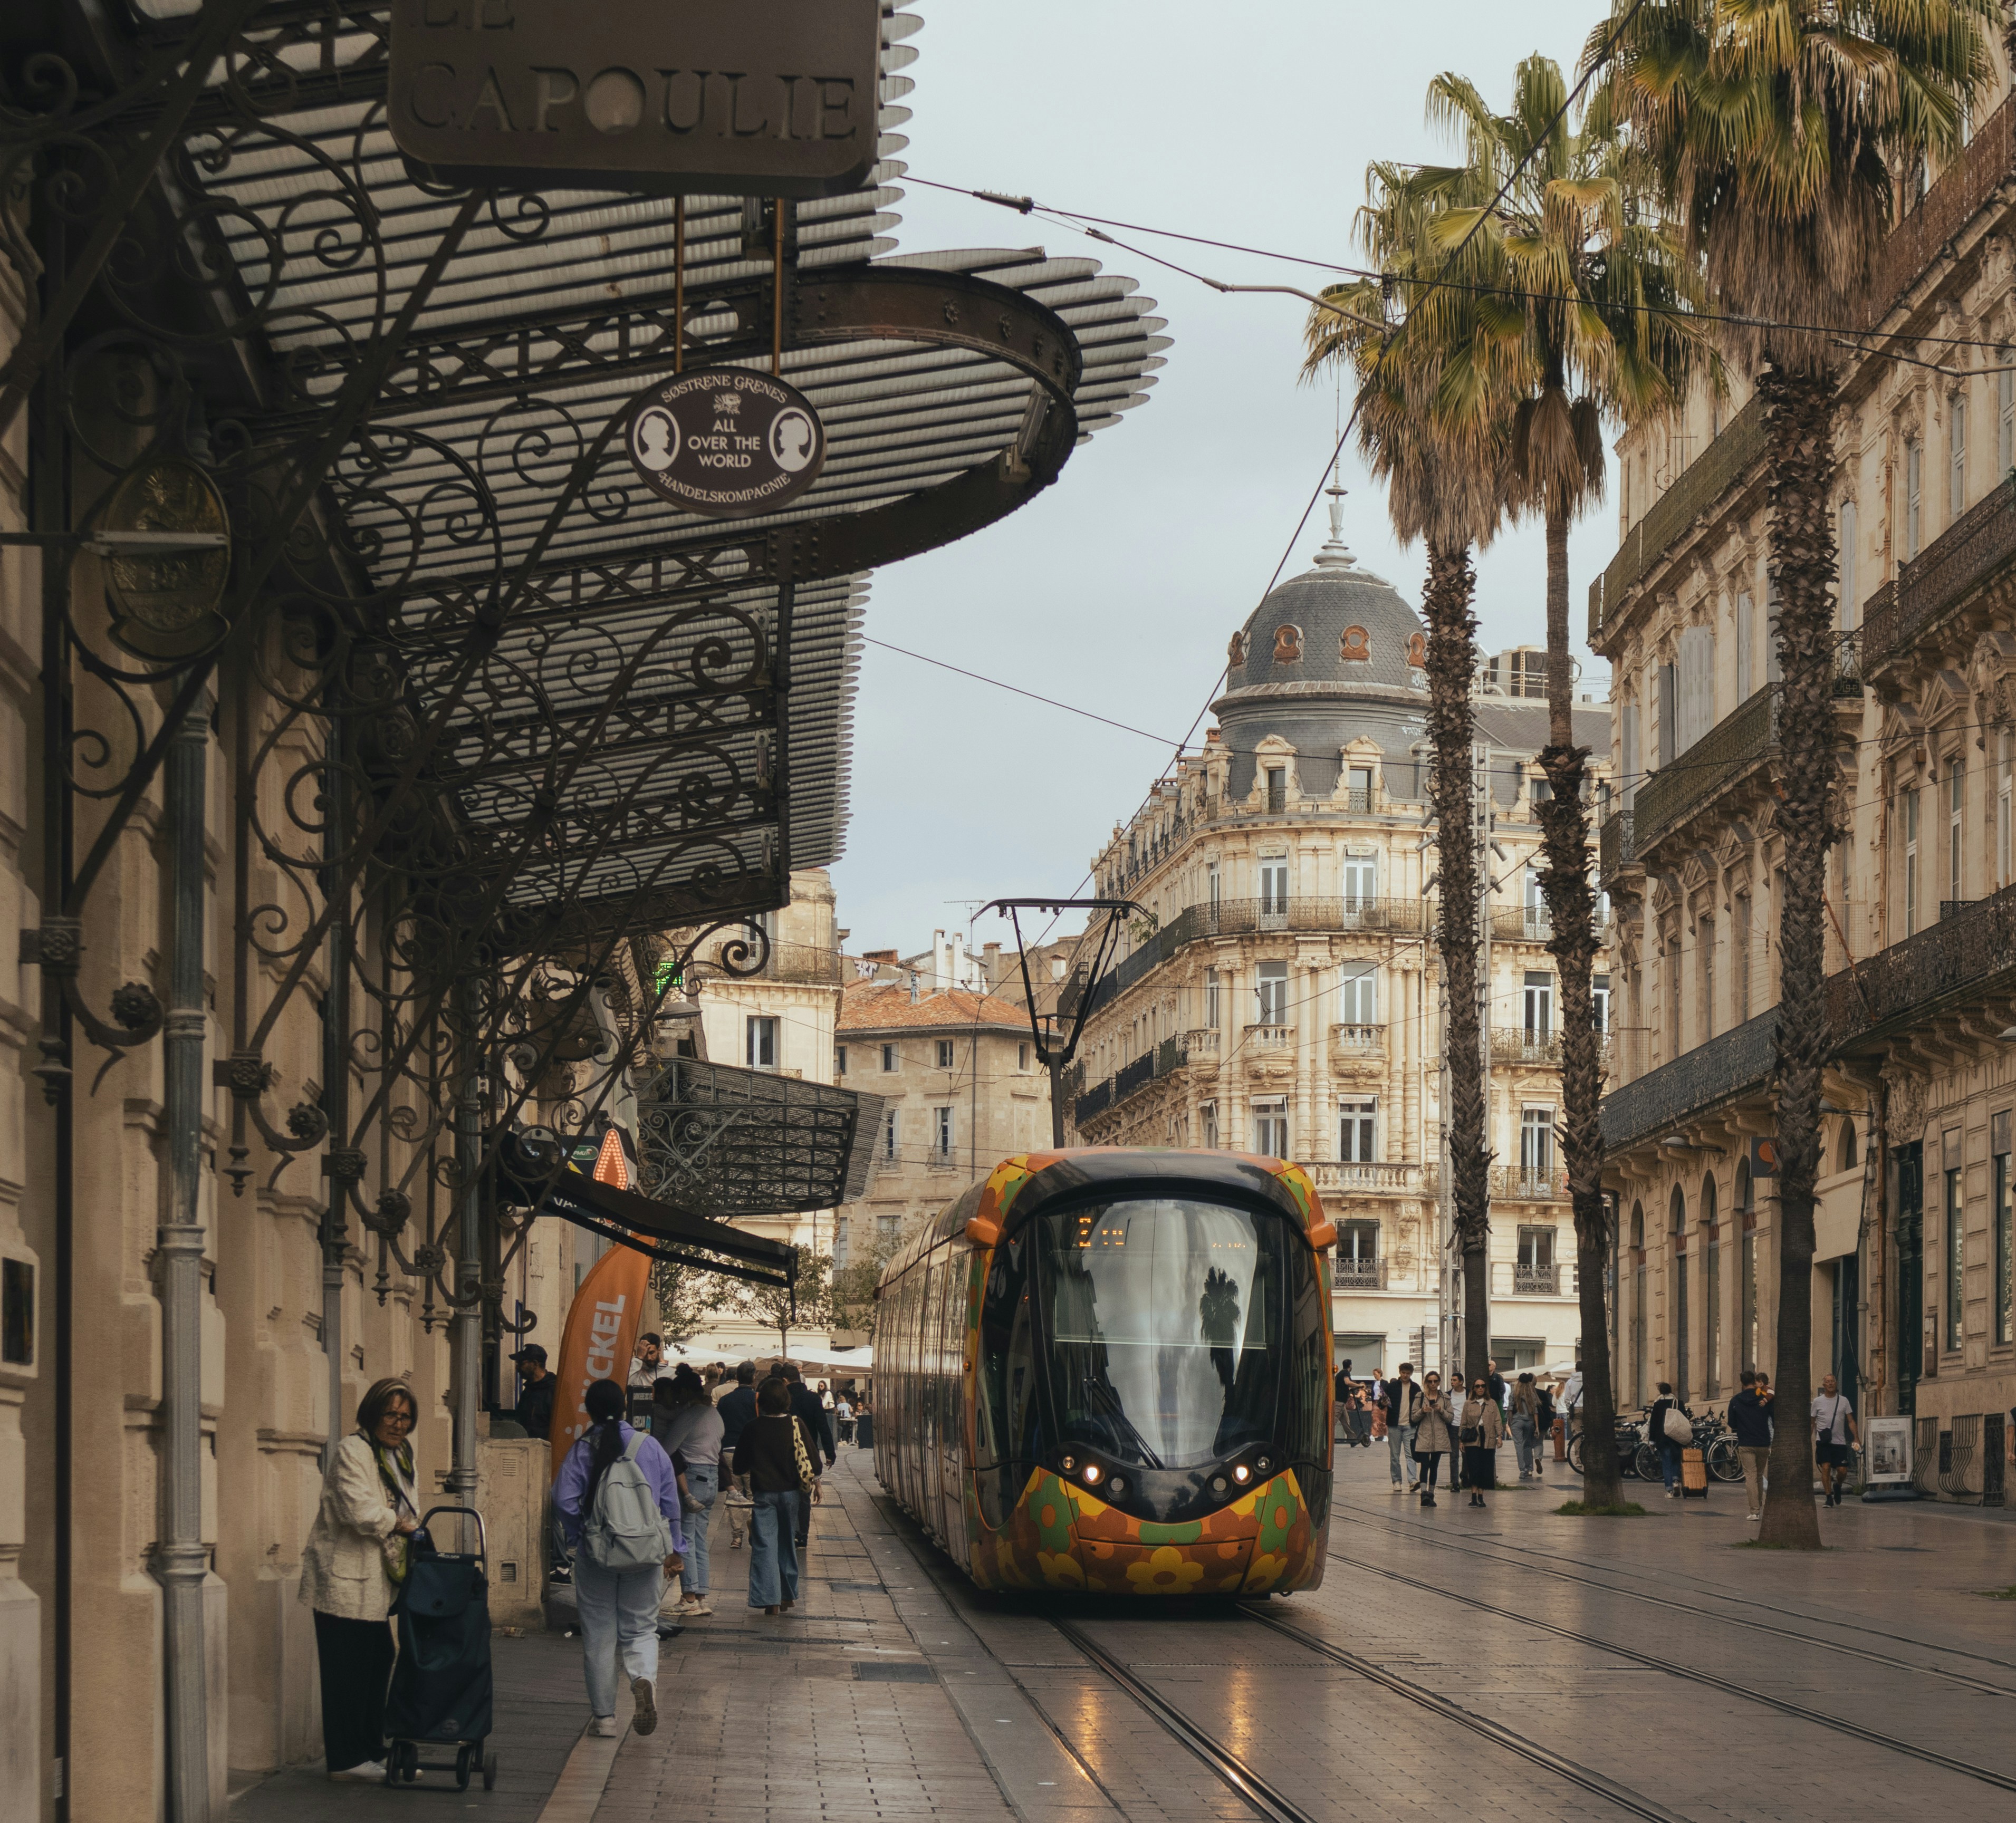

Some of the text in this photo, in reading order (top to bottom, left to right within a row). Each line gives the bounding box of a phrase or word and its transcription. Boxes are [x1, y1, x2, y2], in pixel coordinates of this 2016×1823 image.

[405, 62, 858, 141] CAPOULIE
[660, 374, 788, 404] SØSTRENE GRENES
[713, 419, 737, 432] ALL
[687, 436, 761, 451] OVER THE
[698, 454, 752, 468] WORLD
[658, 471, 792, 503] HANDELSKOMPAGNIE
[553, 1197, 578, 1208] VA
